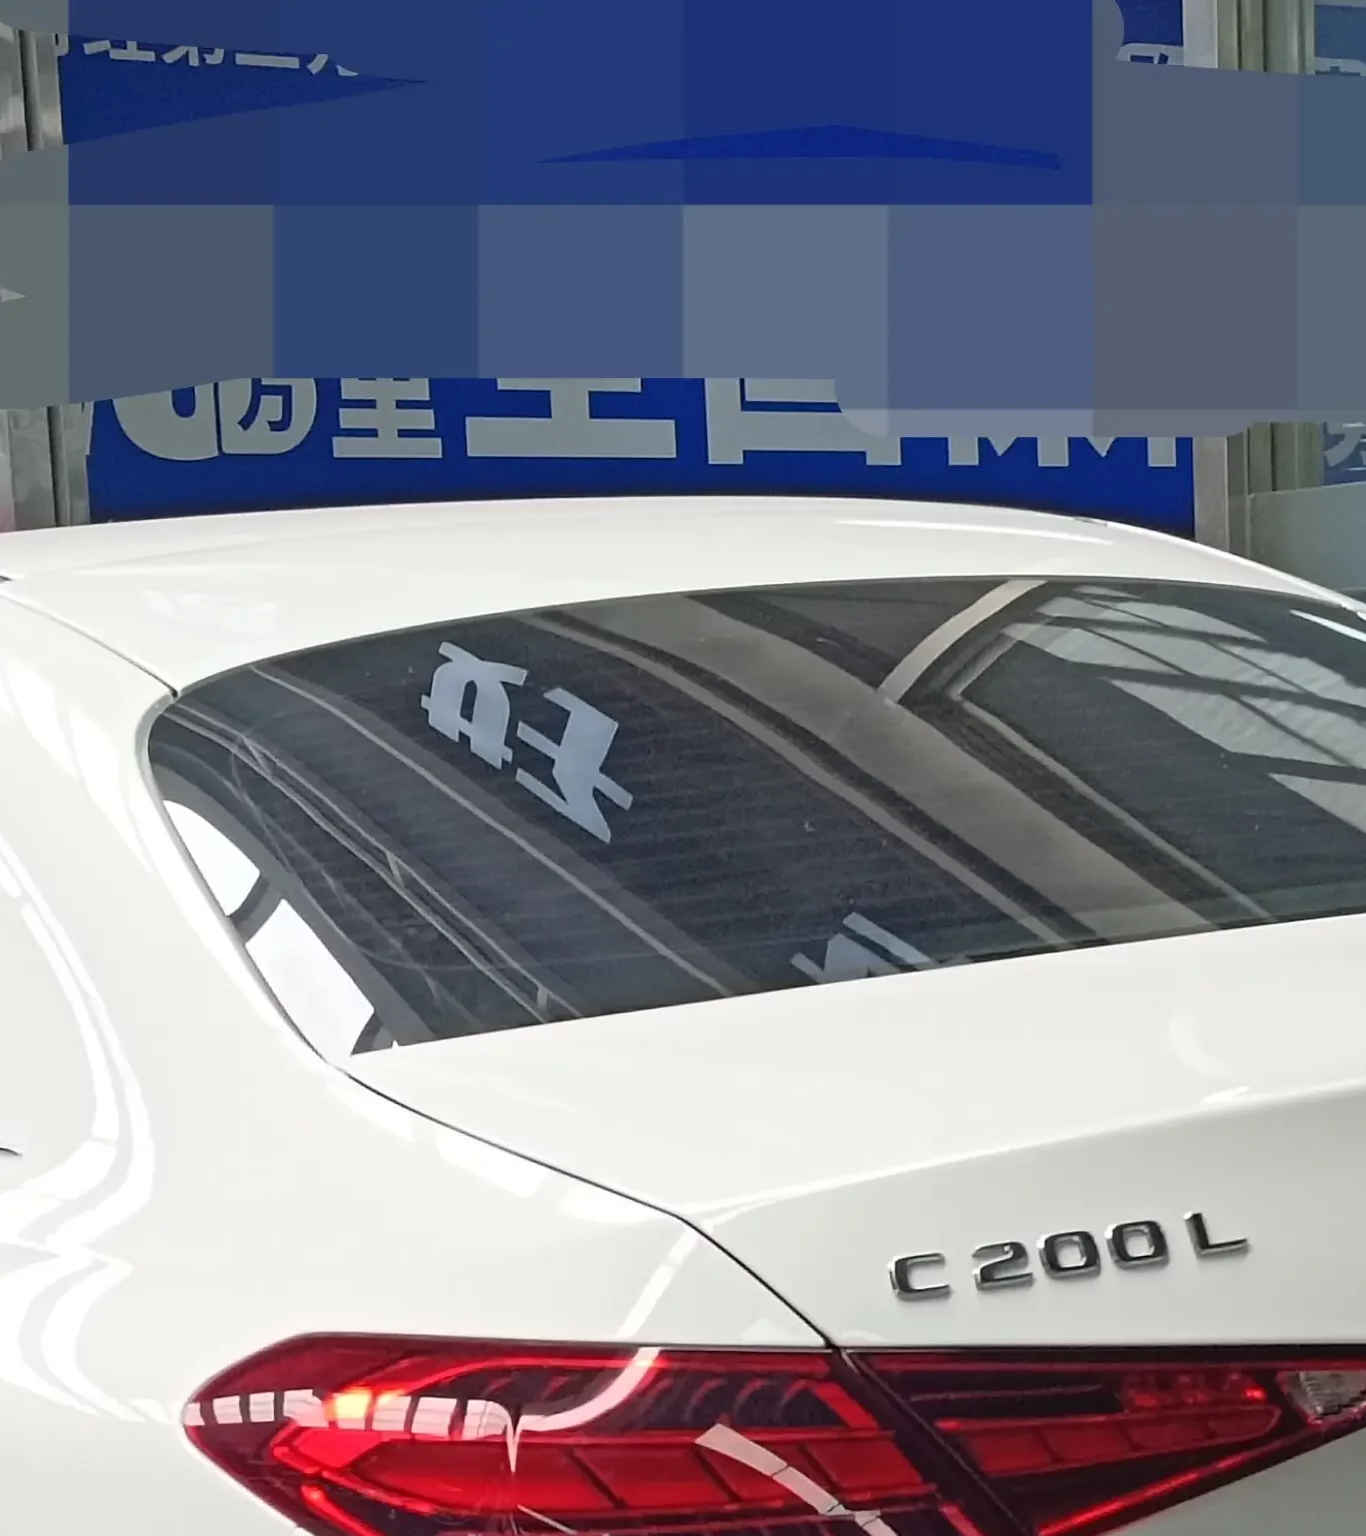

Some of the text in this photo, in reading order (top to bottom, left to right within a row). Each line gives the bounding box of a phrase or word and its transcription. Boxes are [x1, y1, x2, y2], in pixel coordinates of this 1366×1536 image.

[888, 1210, 1251, 1301] C 200 L
